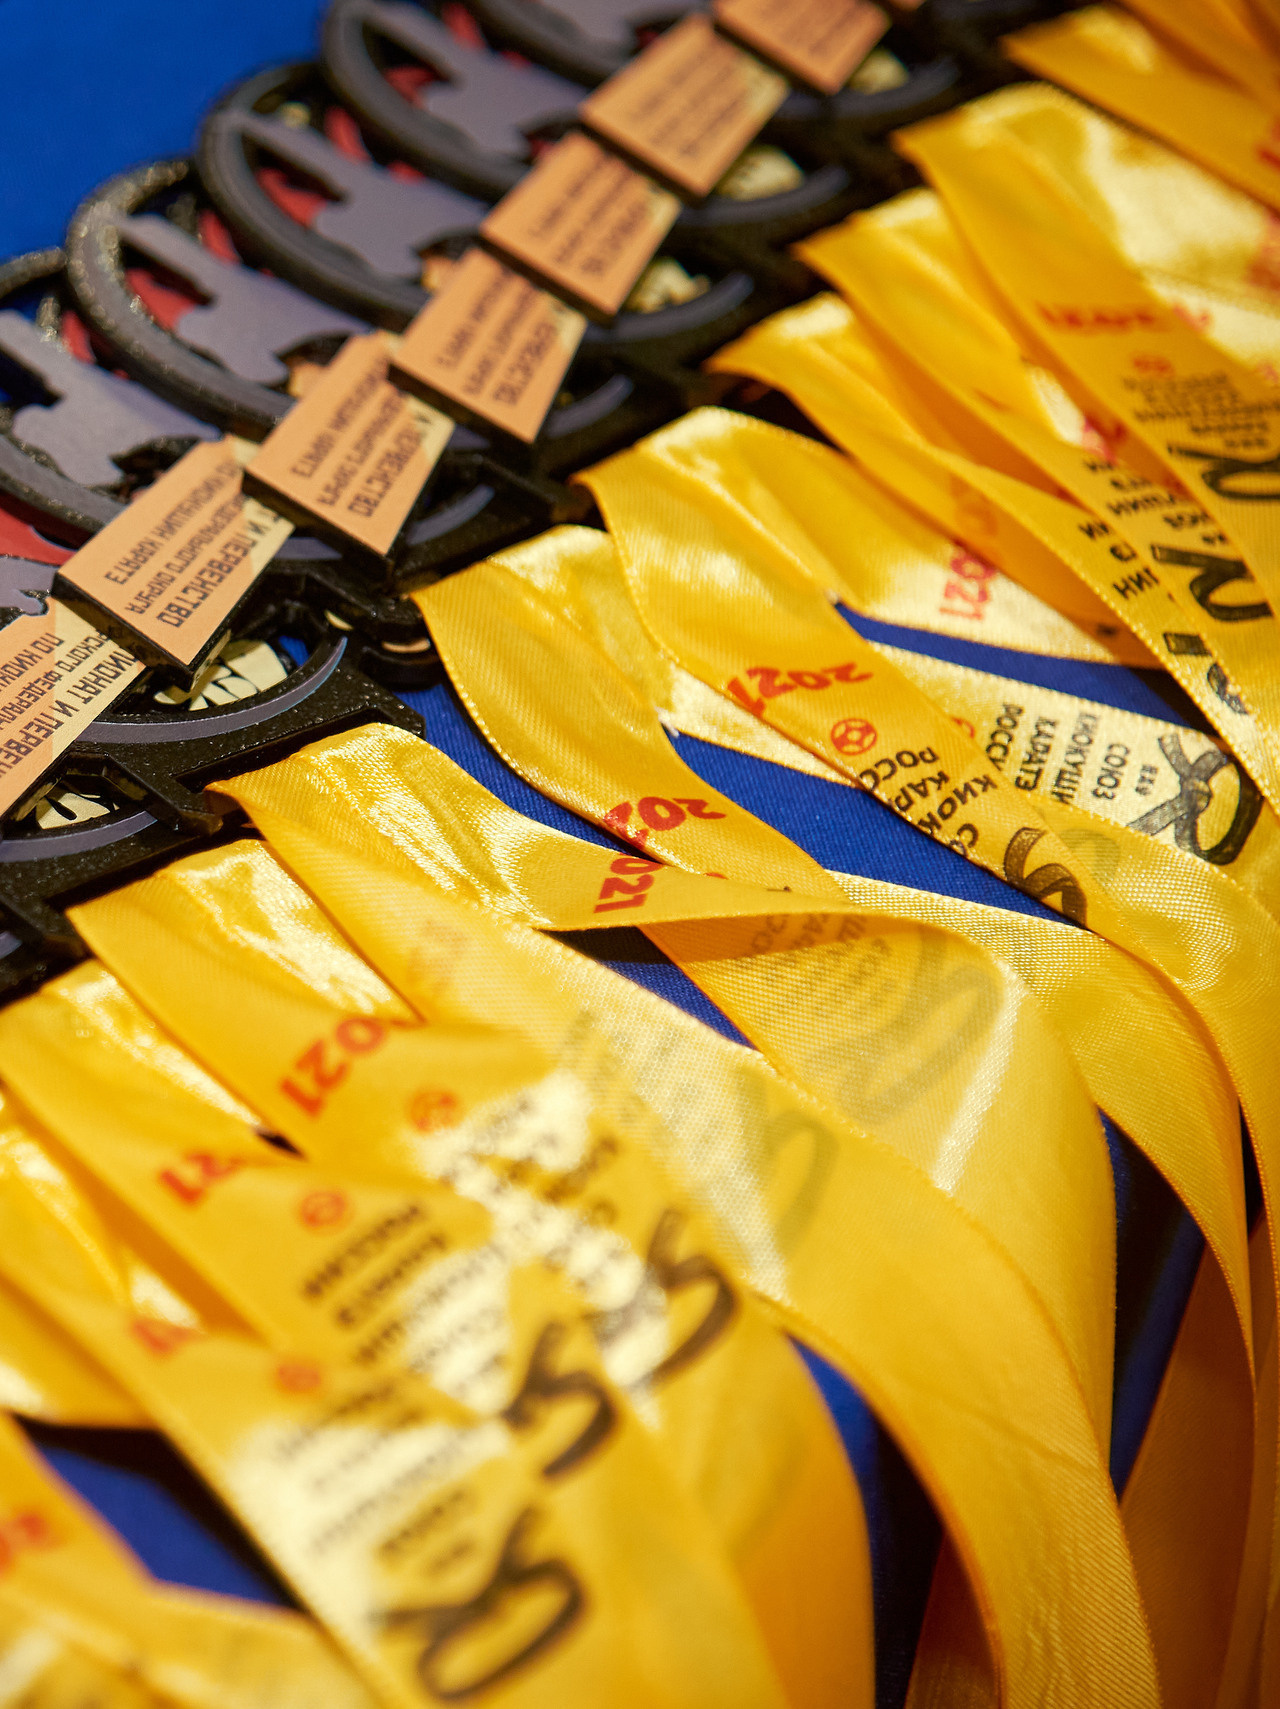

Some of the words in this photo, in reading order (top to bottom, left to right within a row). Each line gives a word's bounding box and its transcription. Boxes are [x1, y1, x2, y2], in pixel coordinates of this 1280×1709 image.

[125, 571, 175, 614] ОКРУГА
[155, 532, 258, 628] ПЕРВЕНСТВО
[37, 632, 65, 654] ПО
[55, 631, 110, 672] РСКОГО
[49, 699, 80, 718] И
[727, 662, 874, 717] 2021
[859, 746, 940, 791] РОСС
[894, 771, 950, 812] КАР
[1092, 742, 1131, 800] СОЮЗ
[918, 774, 998, 835] КИОК
[593, 853, 665, 914] 021
[280, 1017, 384, 1117] 021
